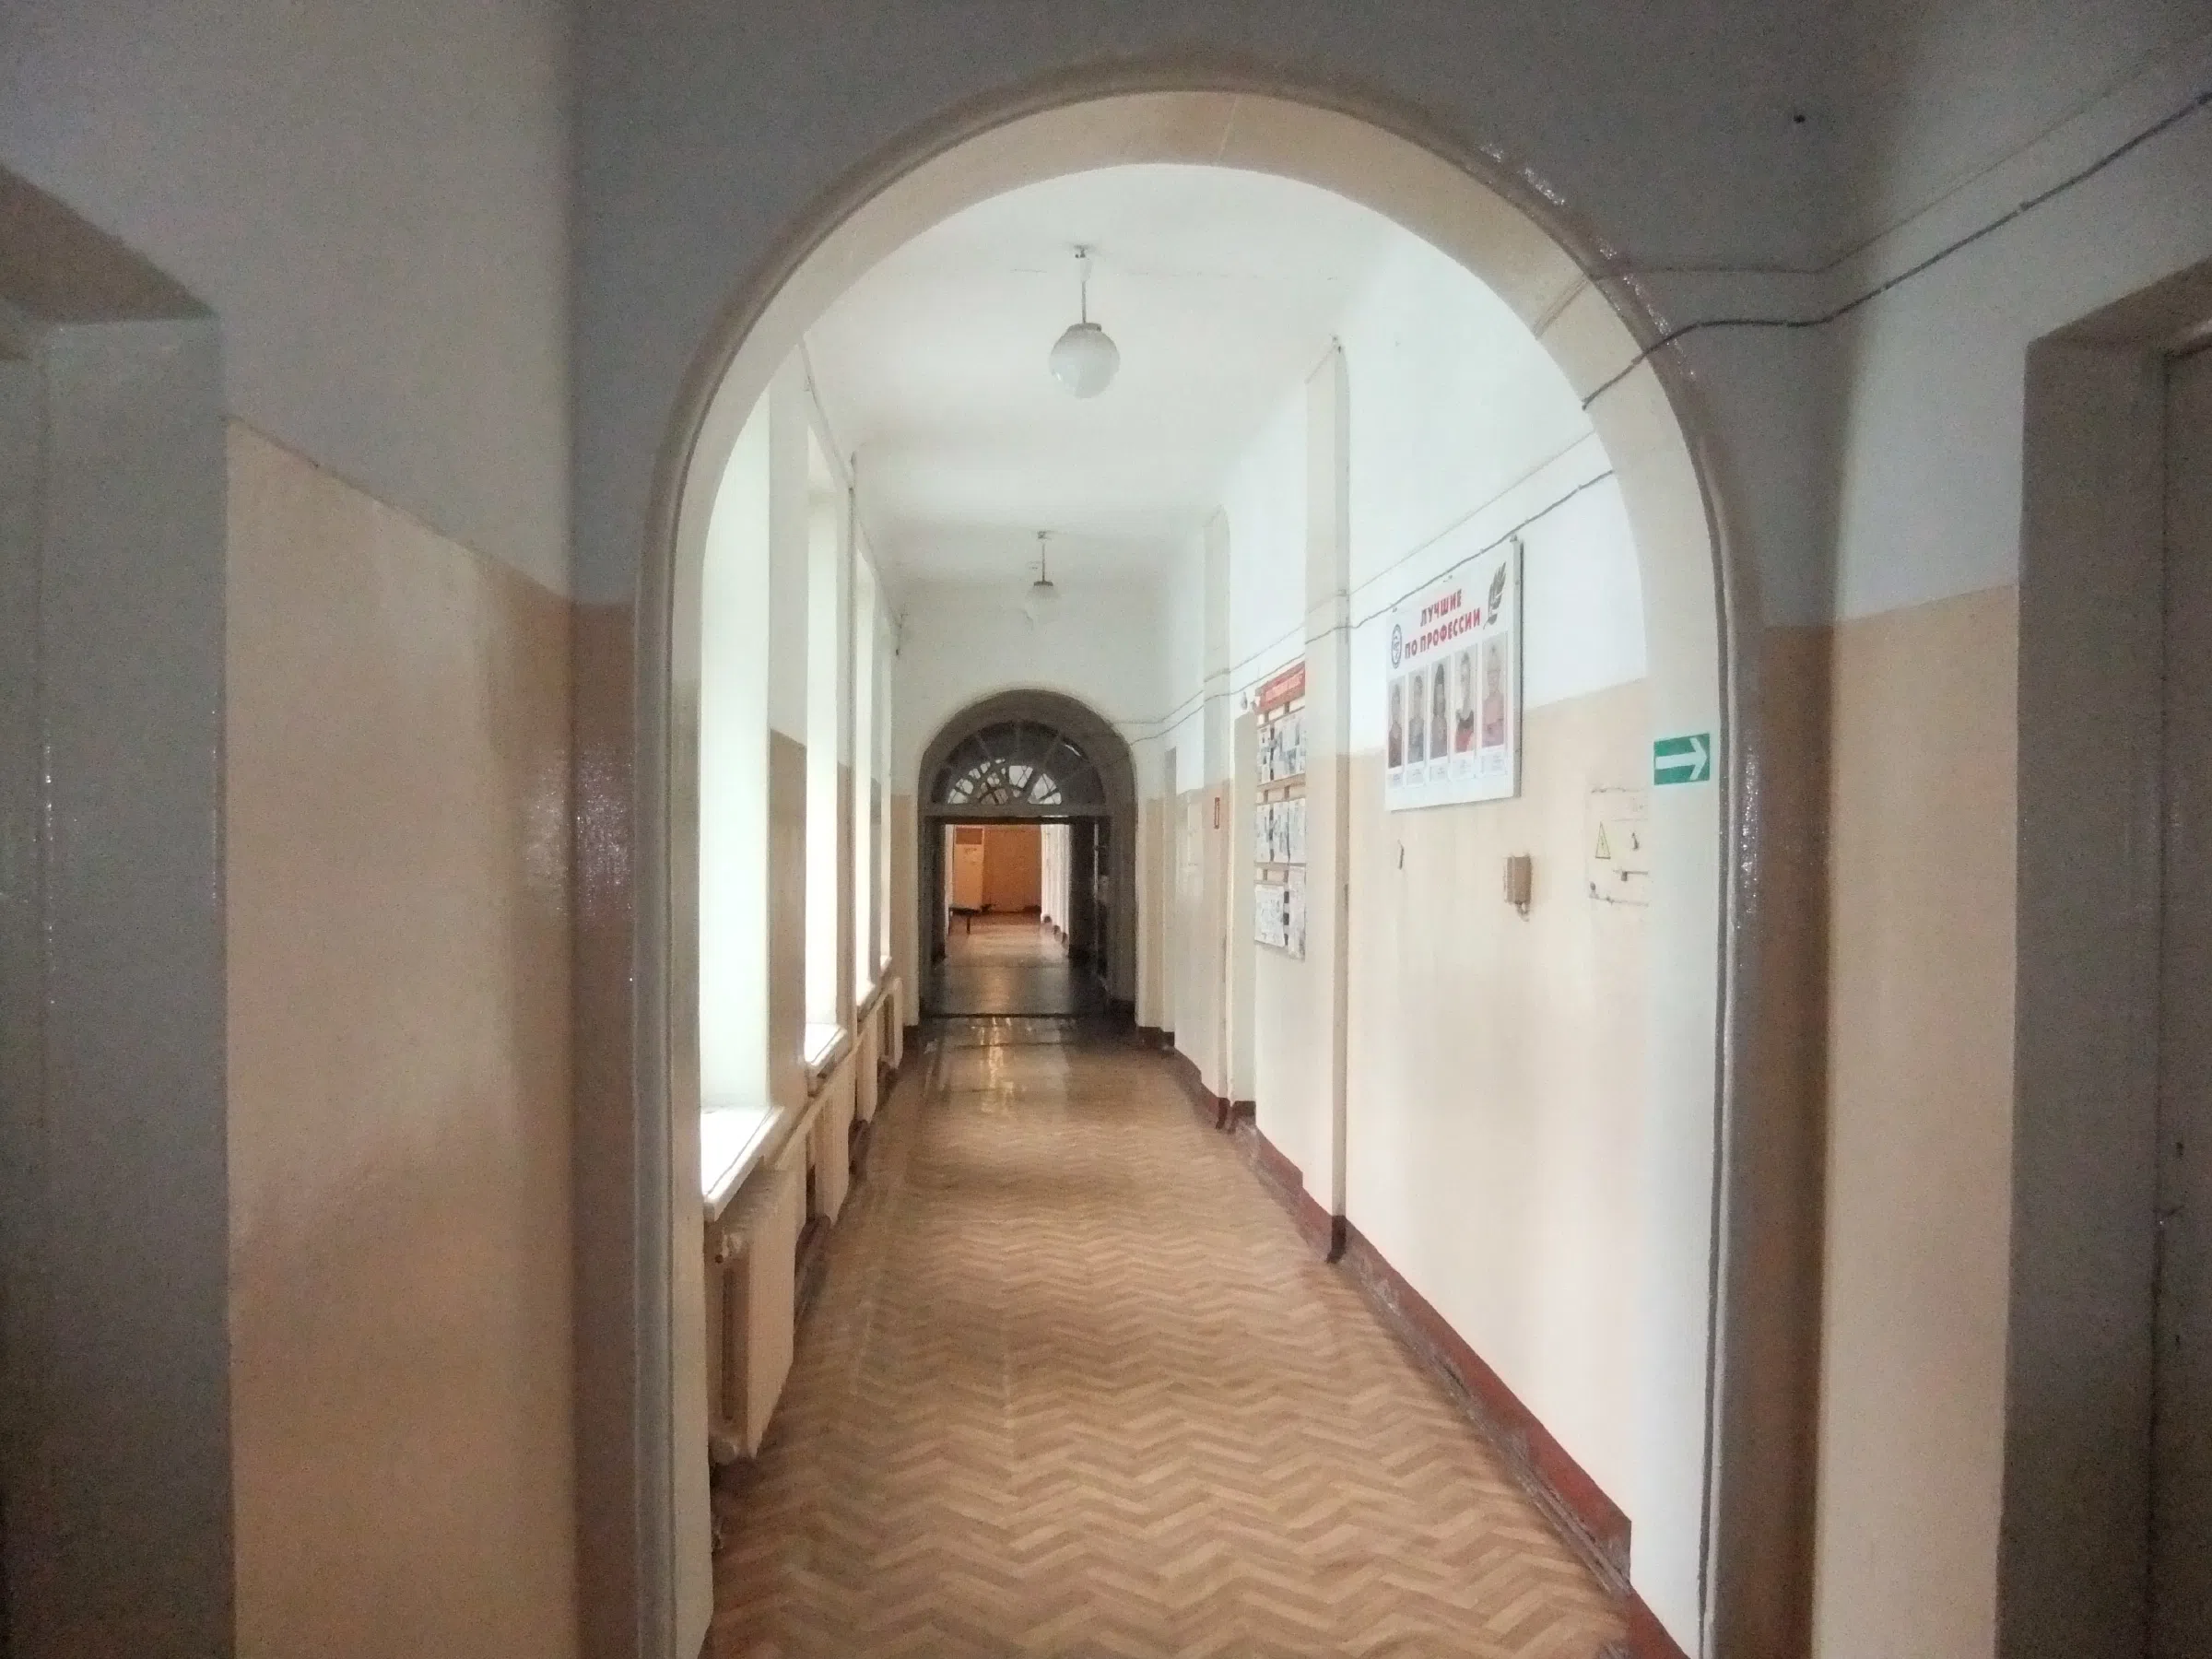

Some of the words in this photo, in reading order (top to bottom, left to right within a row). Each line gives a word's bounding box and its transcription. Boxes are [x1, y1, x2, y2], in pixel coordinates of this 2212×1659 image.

[1420, 589, 1462, 627] ЛУЧШИЕ
[1405, 640, 1418, 659] ПО
[1420, 607, 1480, 653] ПРОФЕССИИ
